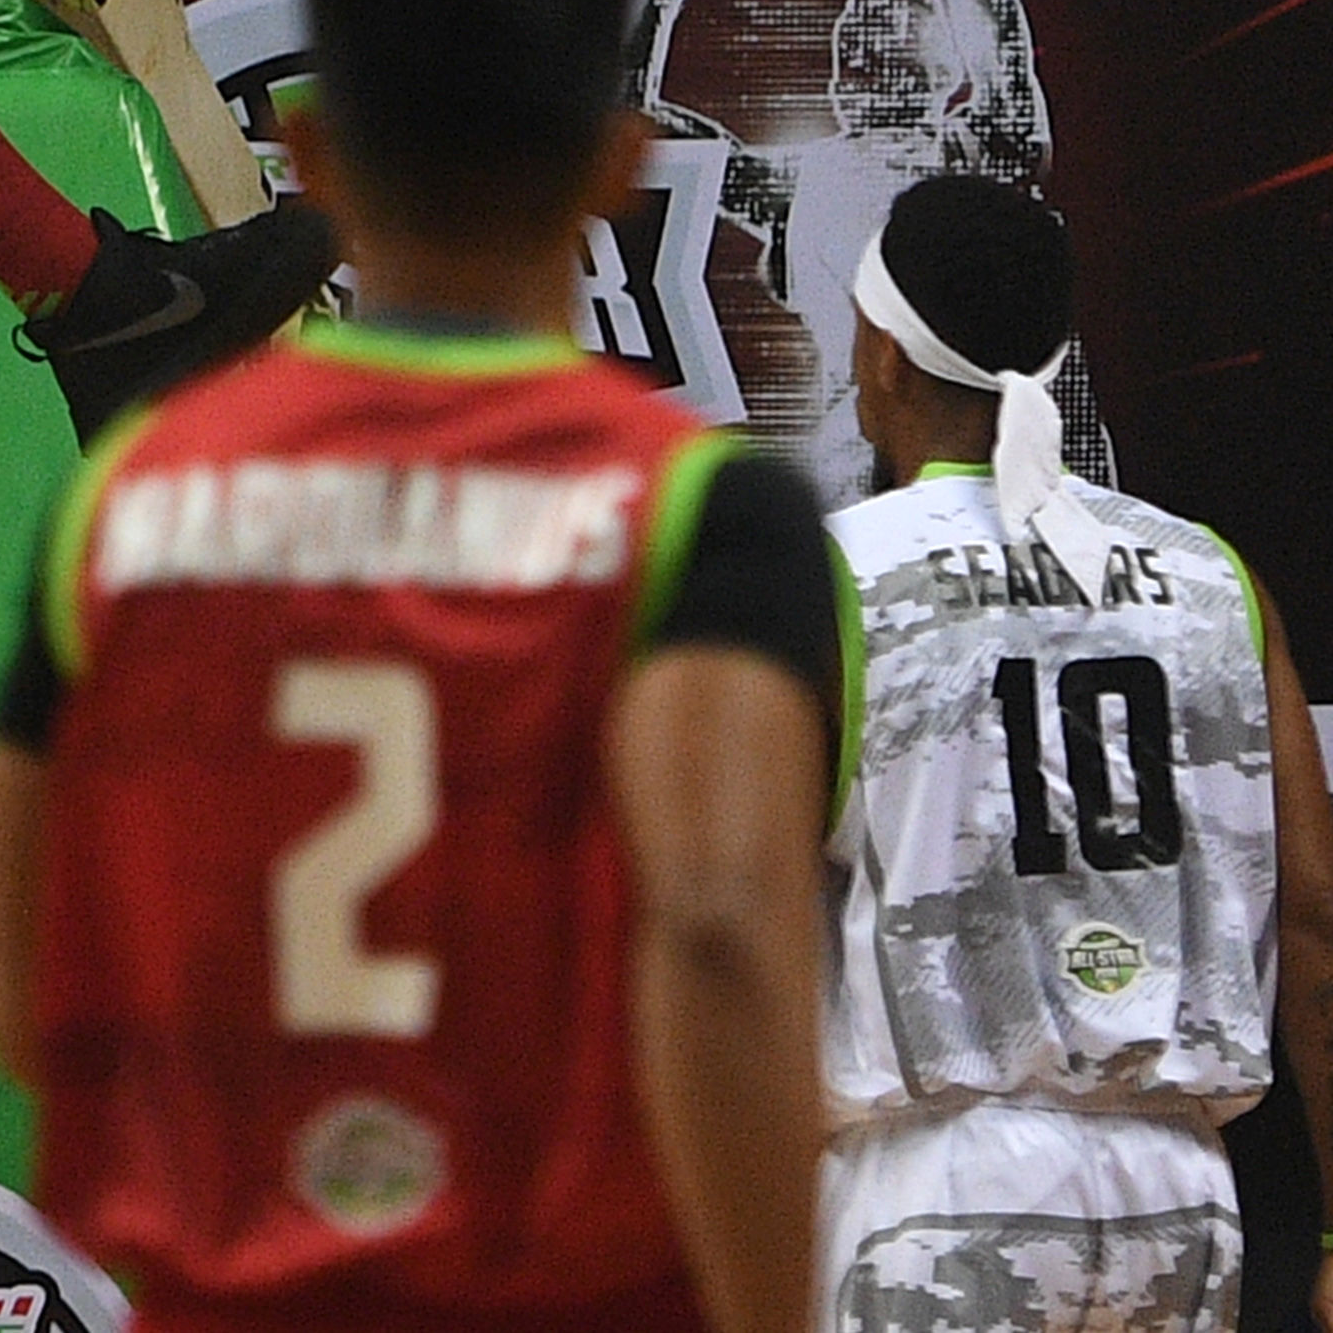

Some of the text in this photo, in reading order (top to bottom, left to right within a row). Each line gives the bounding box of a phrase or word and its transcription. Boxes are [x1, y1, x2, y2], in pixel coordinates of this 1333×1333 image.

[926, 541, 1176, 608] SEAGRS
[273, 659, 439, 1038] 2
[991, 655, 1183, 877] 10
